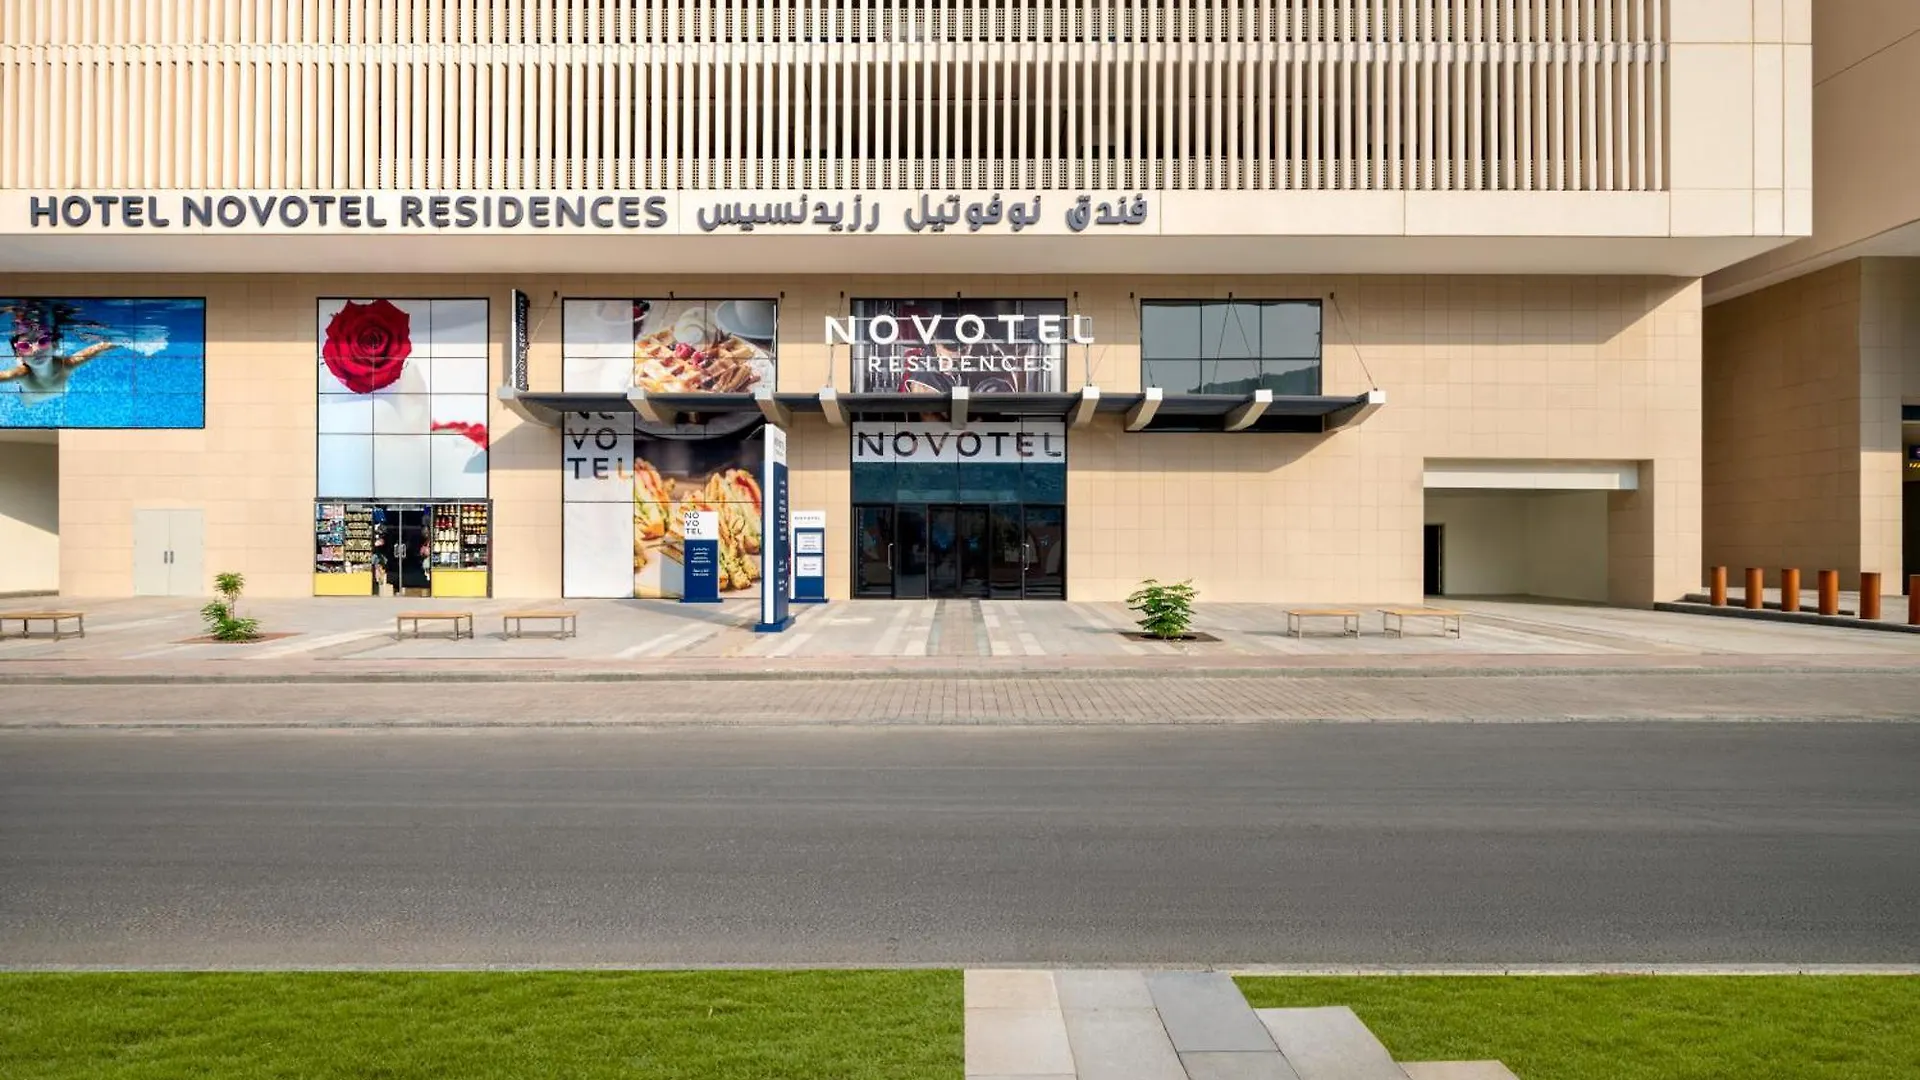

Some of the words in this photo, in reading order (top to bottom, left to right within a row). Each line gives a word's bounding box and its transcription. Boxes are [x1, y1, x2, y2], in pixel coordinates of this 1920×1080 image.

[30, 195, 169, 228] HOTEL
[182, 195, 387, 228] NOVOTEL
[400, 195, 668, 229] RESIDENCES
[697, 193, 881, 232] رزيدنسيس
[904, 193, 1042, 232] نوفوتيل
[1065, 193, 1148, 232] فندق
[824, 314, 1095, 345] NOVOTEL
[868, 355, 1056, 373] RESIDENCES
[567, 427, 618, 450] VO
[857, 431, 1062, 457] NOVOTEL
[567, 457, 632, 480] TEL
